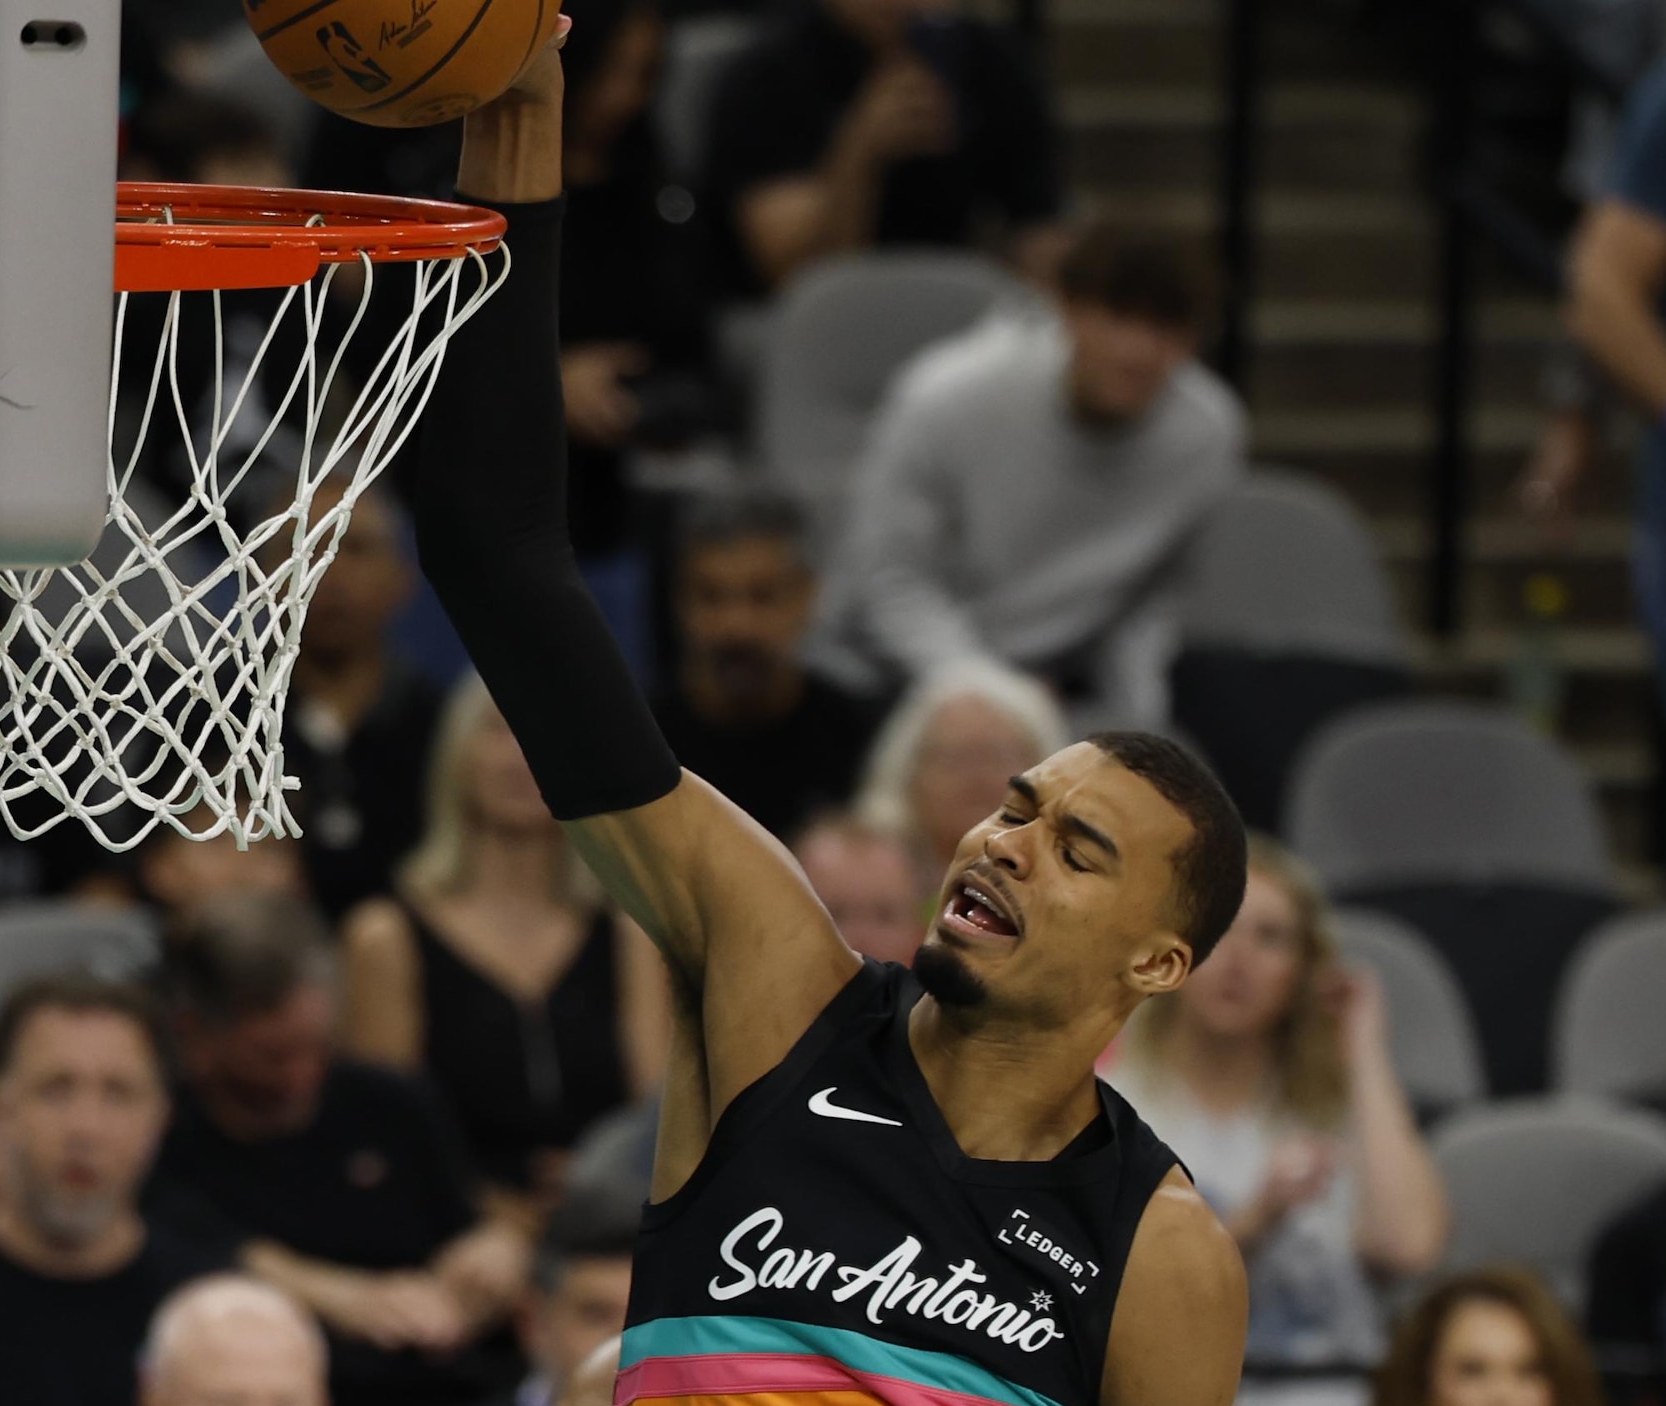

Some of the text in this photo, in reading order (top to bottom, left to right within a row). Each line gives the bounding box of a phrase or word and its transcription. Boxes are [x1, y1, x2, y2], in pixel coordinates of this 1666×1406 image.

[708, 1206, 1065, 1353] San Antonio
[1014, 1223, 1084, 1278] LEDGER
